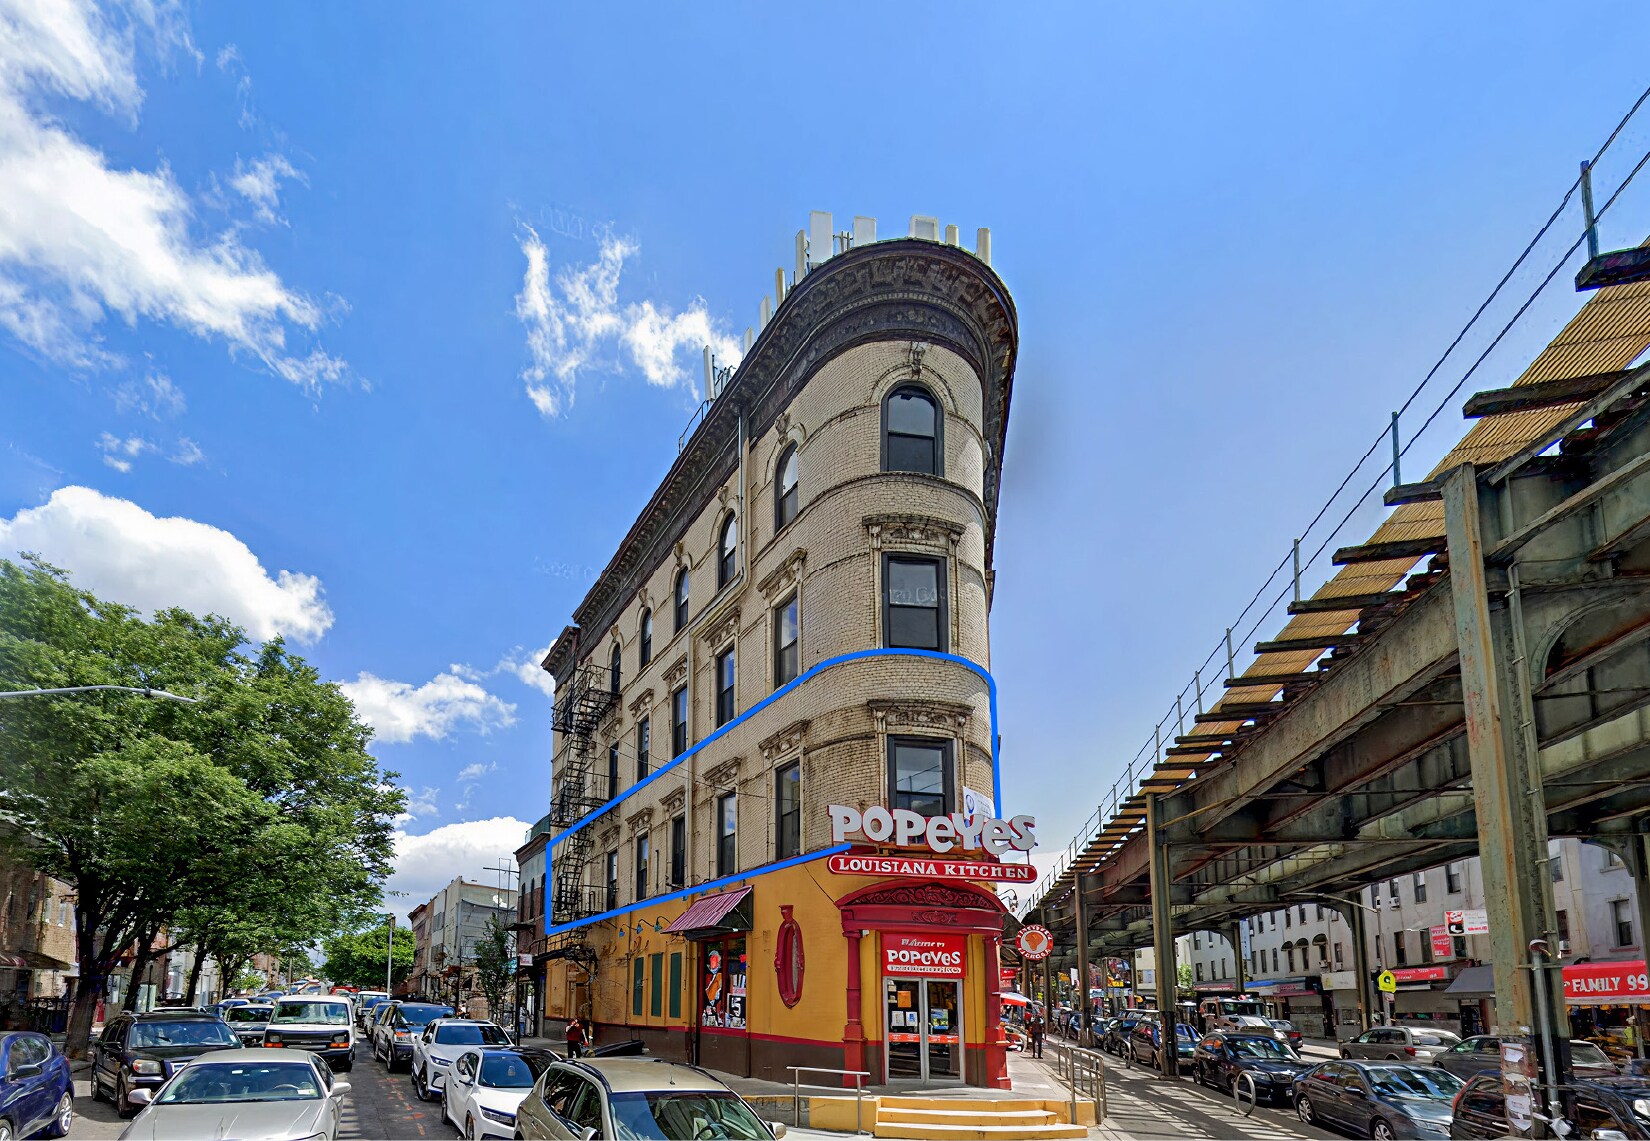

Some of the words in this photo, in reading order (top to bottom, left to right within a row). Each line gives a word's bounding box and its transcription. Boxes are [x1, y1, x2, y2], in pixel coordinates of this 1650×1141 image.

[838, 858, 937, 876] LOUISIANA
[944, 864, 1029, 879] KITCHEN
[1571, 977, 1620, 992] FAMILY
